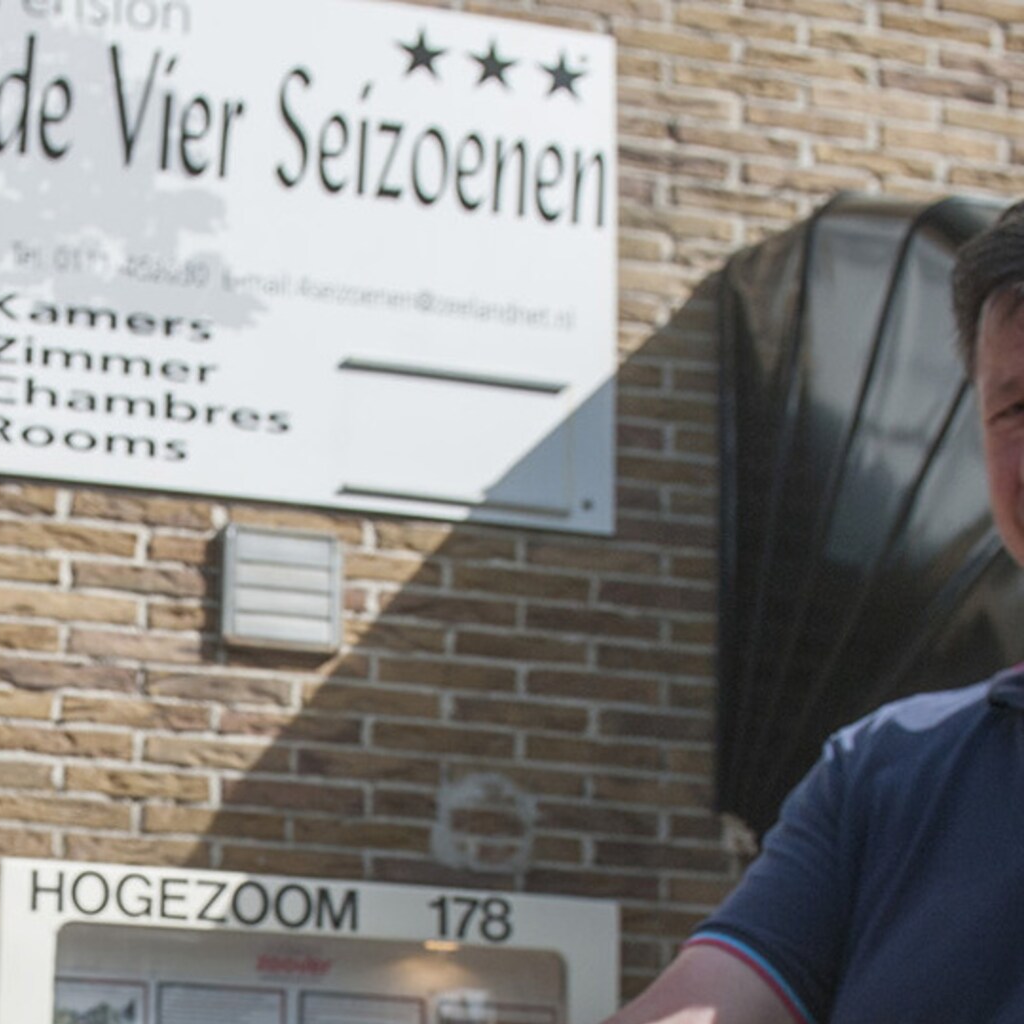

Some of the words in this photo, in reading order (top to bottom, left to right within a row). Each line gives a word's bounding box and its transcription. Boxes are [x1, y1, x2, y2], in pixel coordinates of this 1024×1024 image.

[107, 44, 244, 178] Vier
[276, 67, 606, 228] Seizoenen
[30, 869, 359, 932] HOGEZOOM
[428, 896, 513, 943] 178
